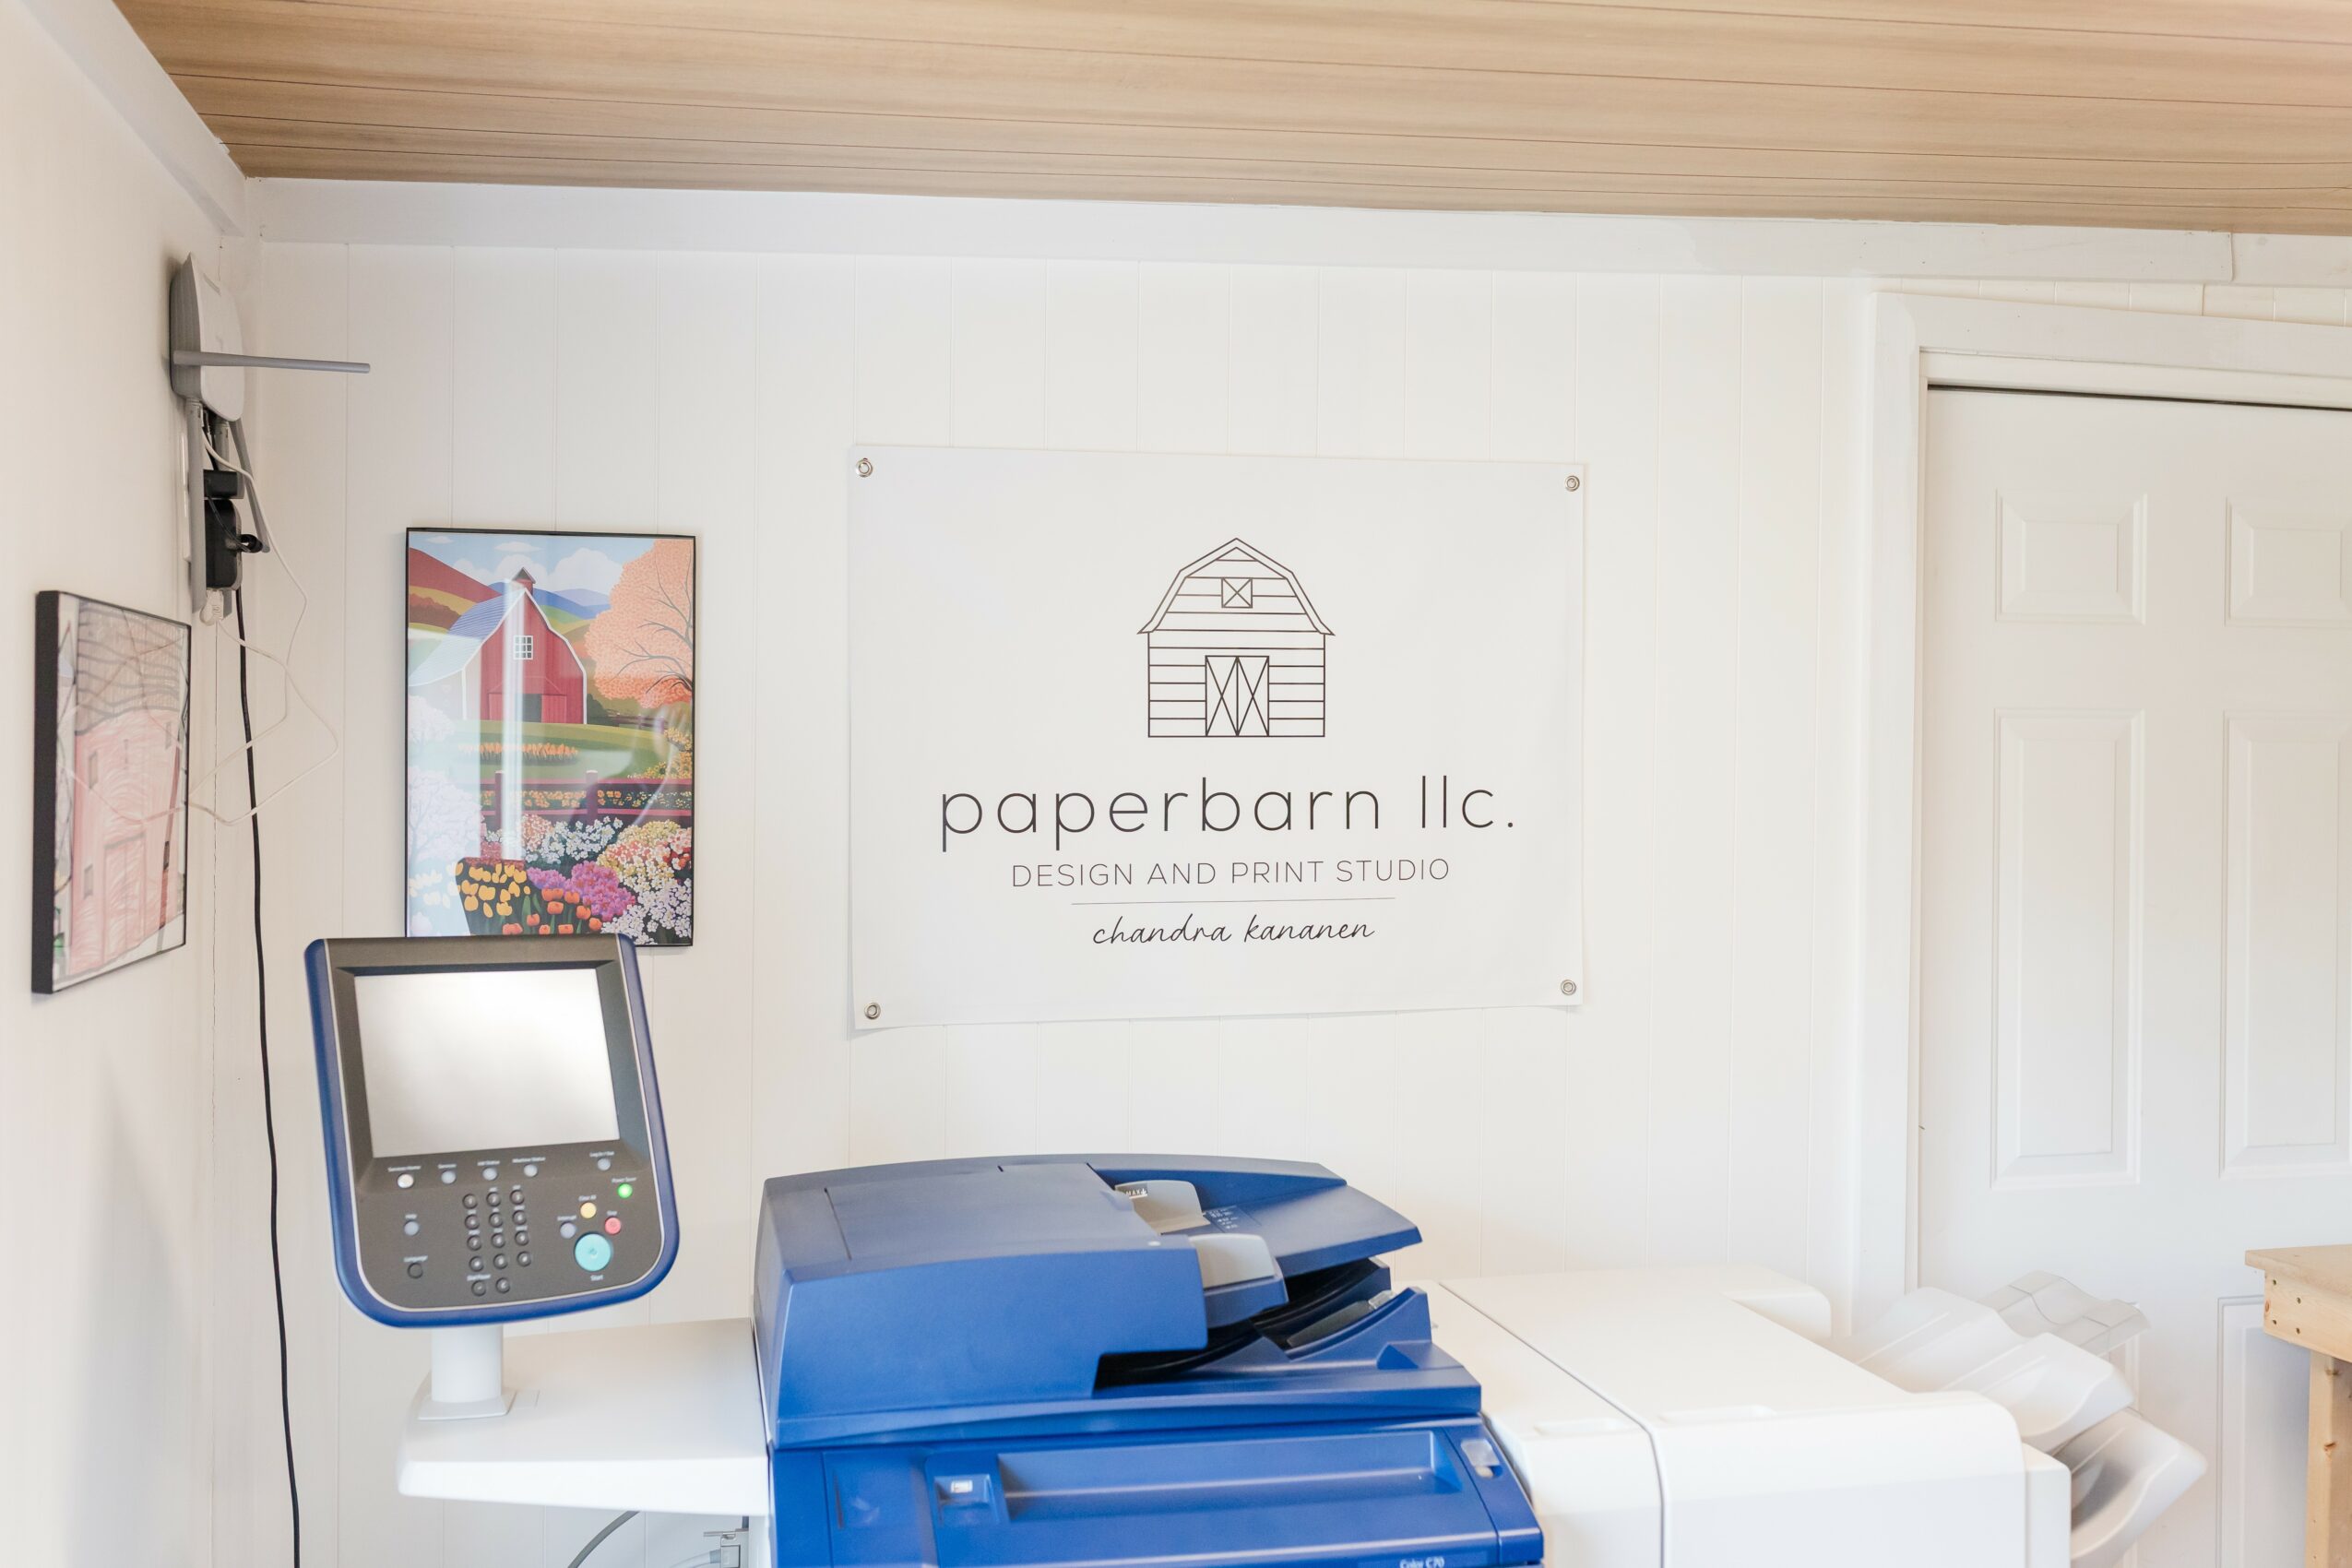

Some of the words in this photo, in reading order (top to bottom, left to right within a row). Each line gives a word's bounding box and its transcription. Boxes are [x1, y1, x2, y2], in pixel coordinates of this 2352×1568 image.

[943, 777, 1379, 852] paperbarn
[1422, 775, 1514, 828] llc.
[1013, 863, 1133, 886] DESIGN
[1147, 862, 1217, 885] AND
[1232, 861, 1324, 884] PRINT
[1336, 858, 1450, 883] STUDIO
[1093, 913, 1233, 944] chandra
[1244, 914, 1375, 944] kananen
